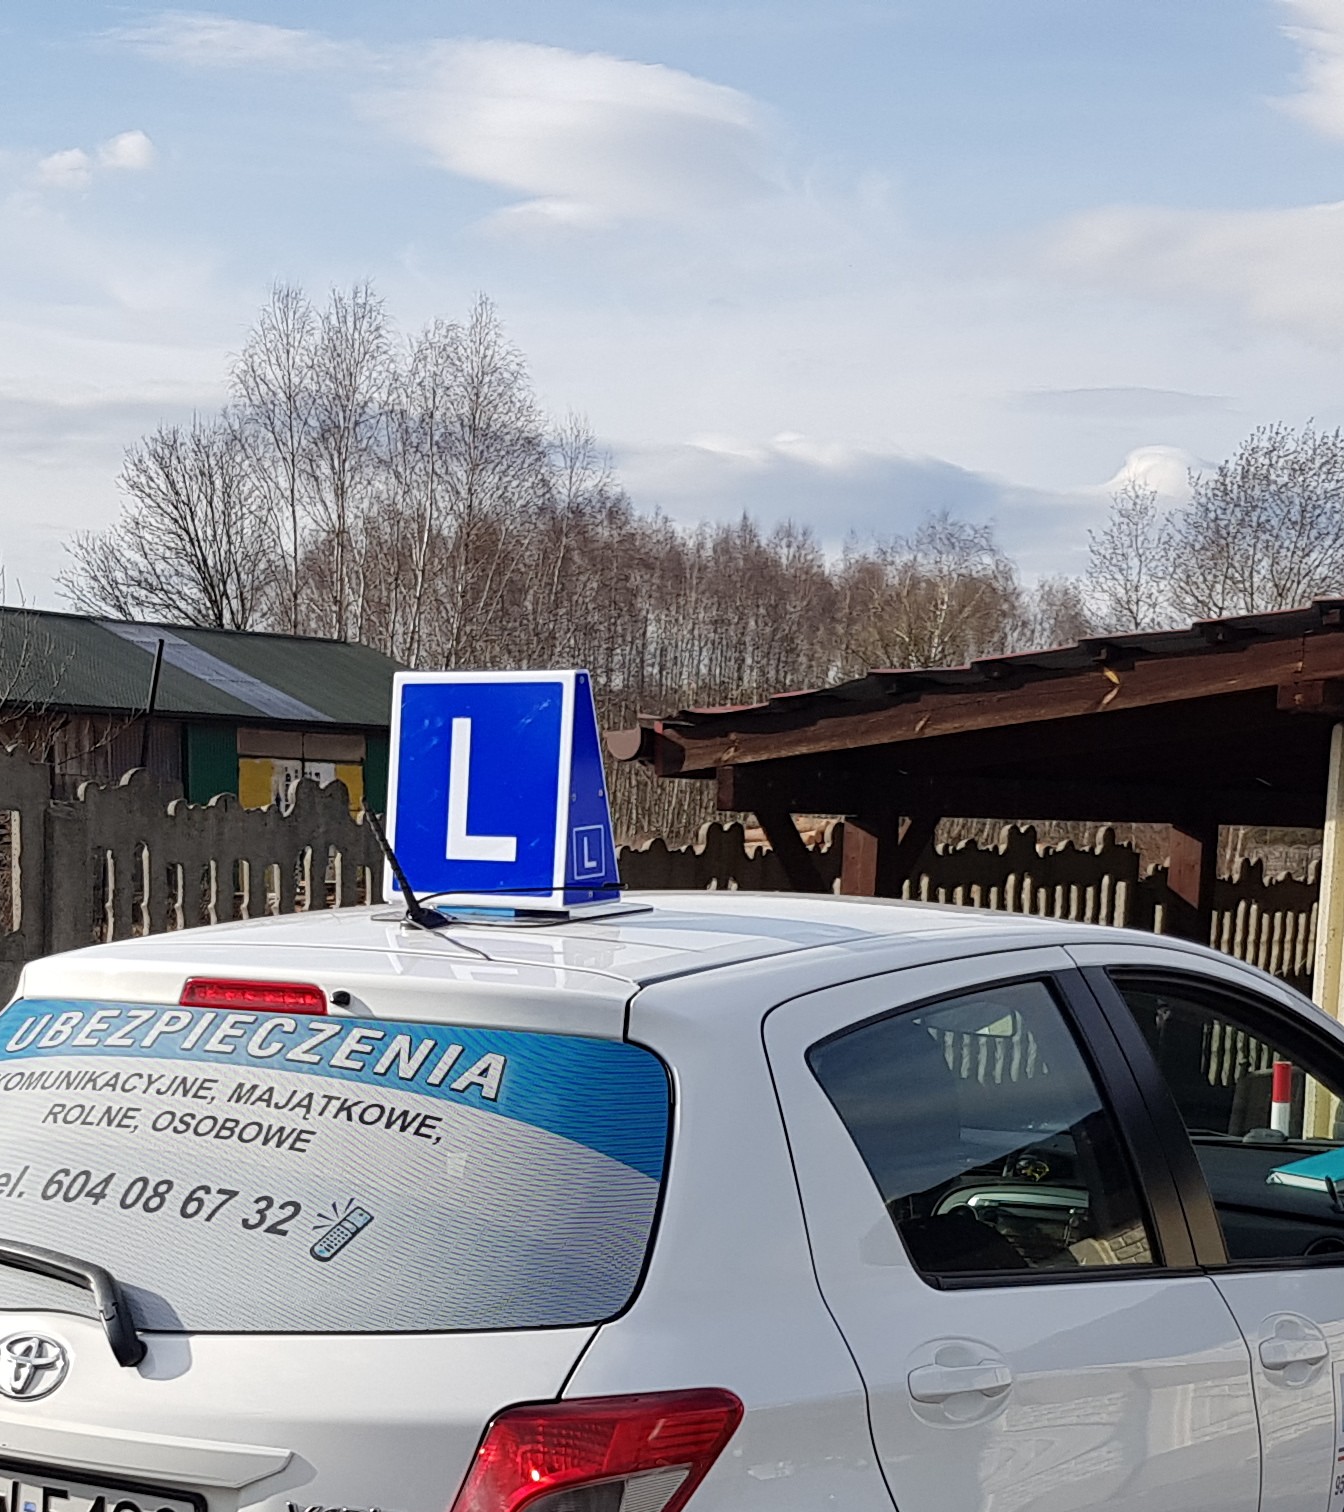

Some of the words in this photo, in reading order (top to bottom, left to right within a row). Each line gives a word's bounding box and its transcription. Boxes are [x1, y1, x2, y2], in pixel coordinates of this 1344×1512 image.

[446, 717, 517, 862] L
[583, 836, 597, 869] L
[4, 1008, 507, 1103] UBEZPIECZENIA
[41, 1103, 140, 1135] ROLNE,
[152, 1110, 317, 1154] OSOBOWE
[226, 1081, 446, 1146] MAJĄTKOWE,
[40, 1167, 113, 1207] 604
[119, 1176, 174, 1214] 08
[180, 1184, 240, 1223] 67
[241, 1196, 303, 1237] 32
